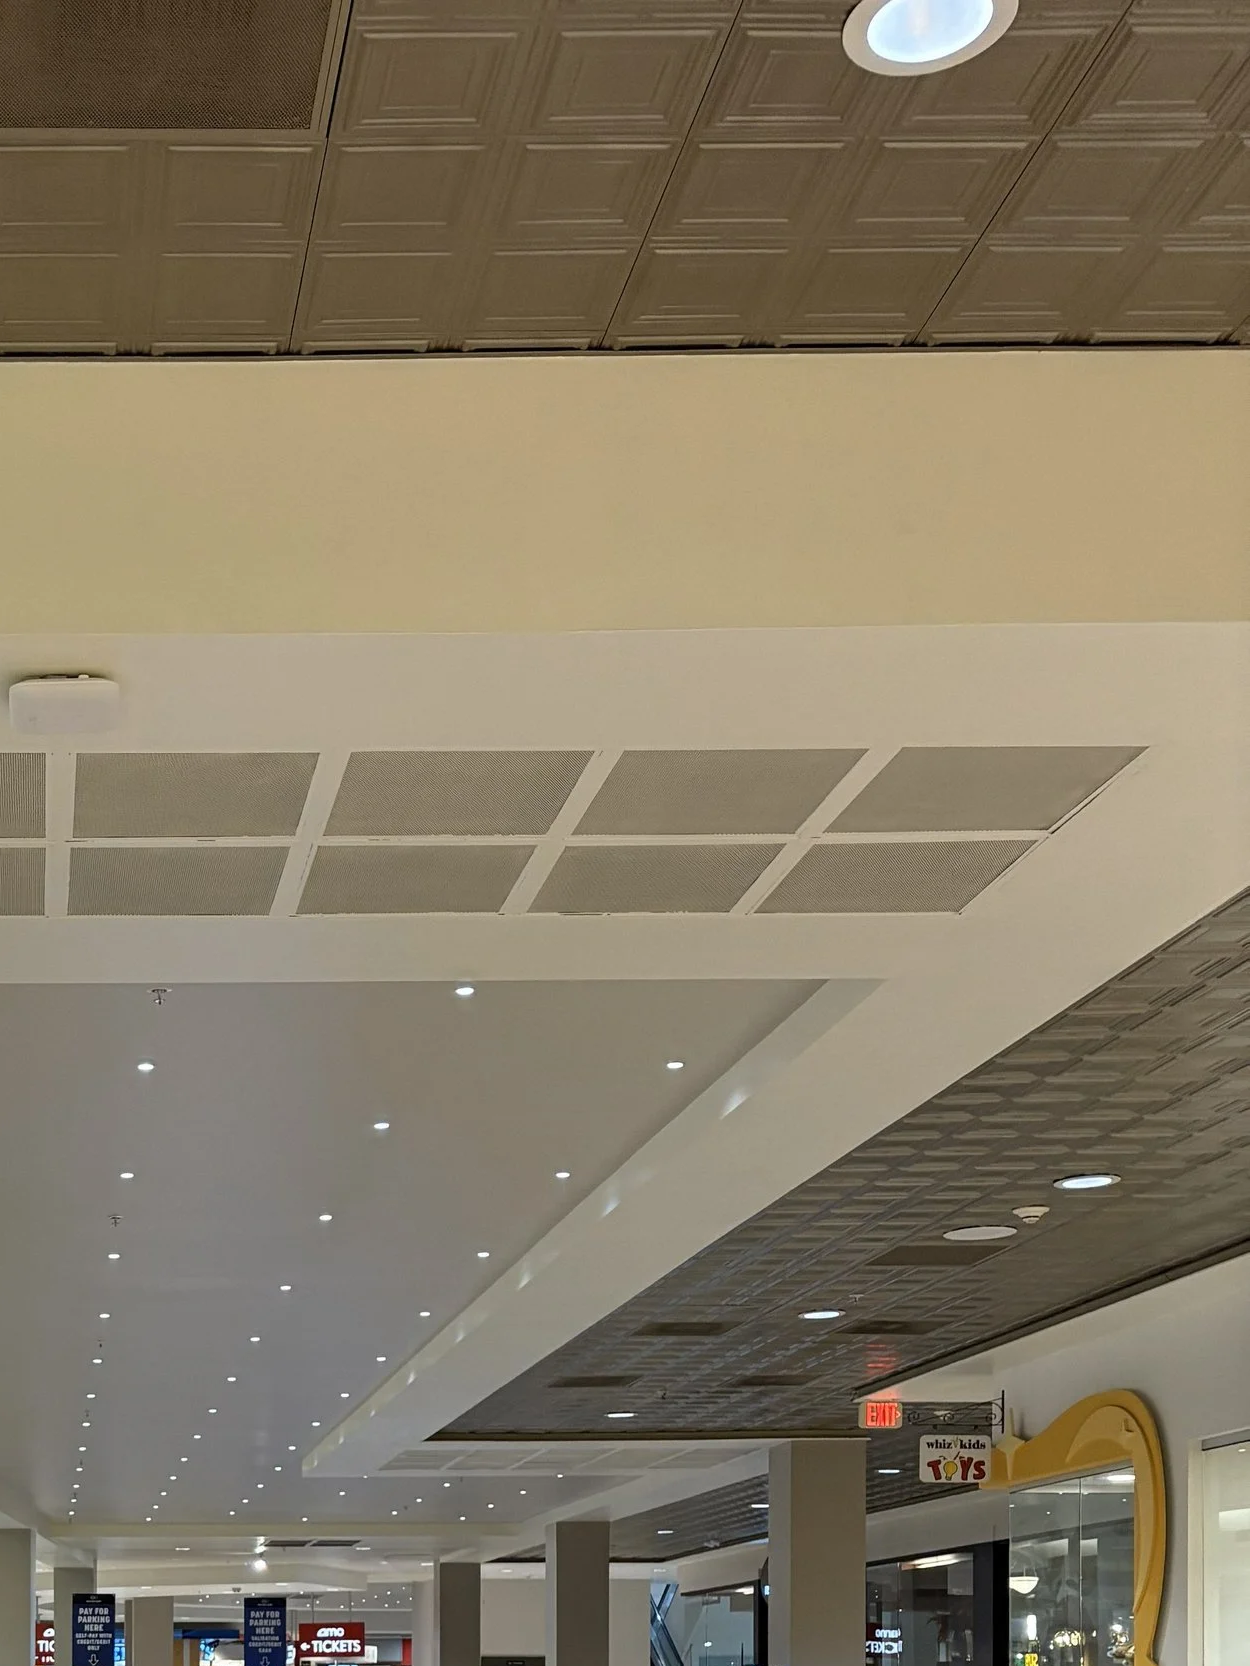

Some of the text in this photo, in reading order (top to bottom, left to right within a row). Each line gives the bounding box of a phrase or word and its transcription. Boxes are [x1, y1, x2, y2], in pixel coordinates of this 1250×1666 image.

[866, 1402, 898, 1427] EXIT
[926, 1438, 986, 1450] whiz kids
[927, 1456, 986, 1481] TOYS
[311, 1640, 361, 1653] TICKETS
